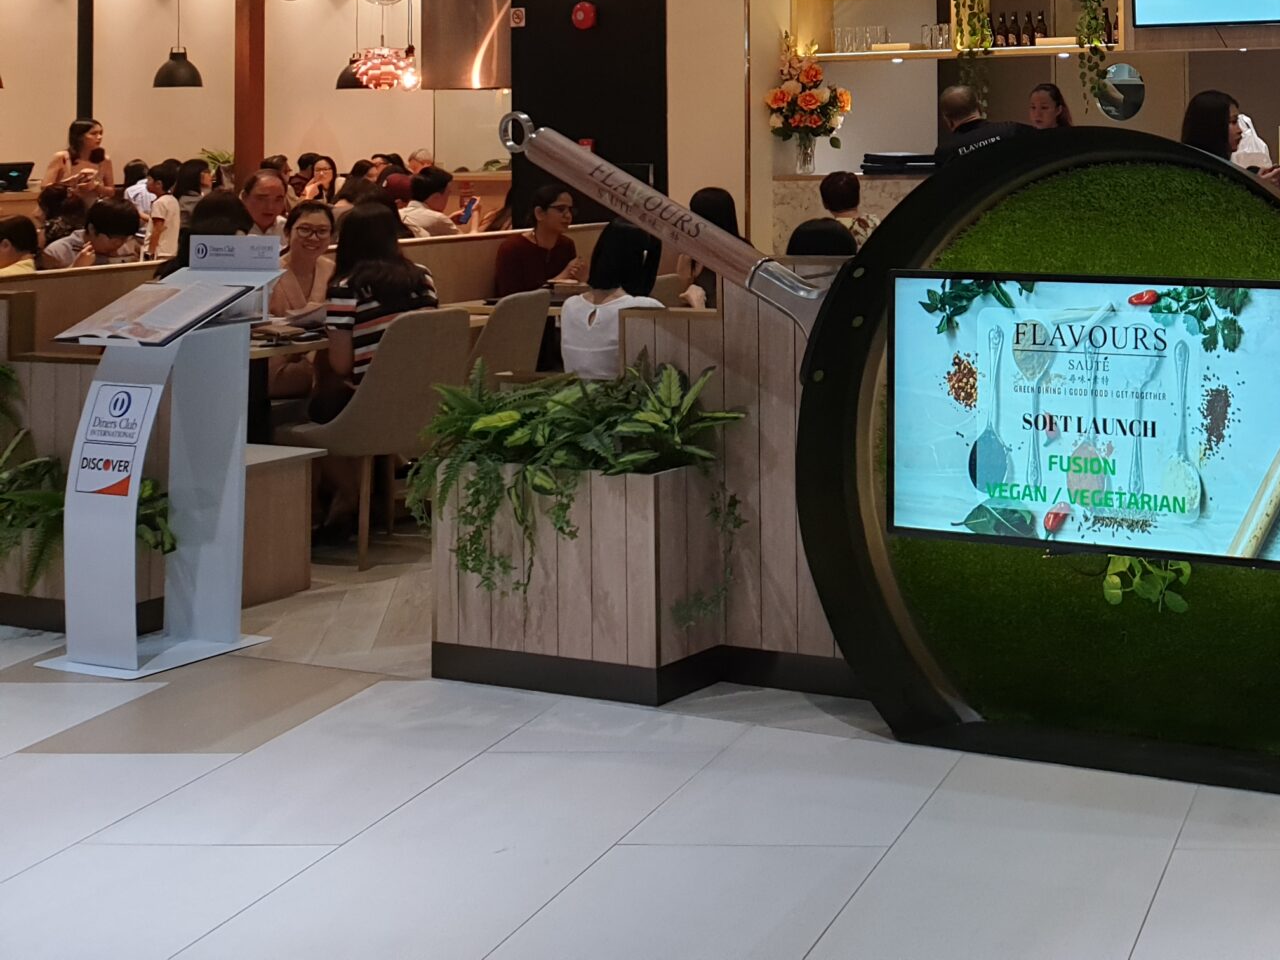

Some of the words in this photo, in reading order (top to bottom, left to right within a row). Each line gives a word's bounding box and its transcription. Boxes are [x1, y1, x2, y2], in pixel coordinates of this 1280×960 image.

[1013, 322, 1168, 352] FLAVOURS
[1013, 384, 1035, 394] GREEN
[1037, 386, 1062, 396] DINING
[1069, 387, 1088, 397] GOOD
[1091, 389, 1109, 399] FOOD
[1116, 390, 1128, 399] GET
[1131, 391, 1167, 402] TOGETHER
[92, 416, 117, 429] Diners
[119, 417, 138, 430] Club
[1022, 412, 1073, 434] SOFT
[1076, 416, 1157, 439] LAUNCH
[89, 429, 136, 439] INTERNATIONAL
[81, 457, 130, 473] DISCOVER
[1048, 454, 1117, 476] FUSION
[986, 481, 1048, 503] VEGAN
[1067, 489, 1187, 514] VEGETARIAN
